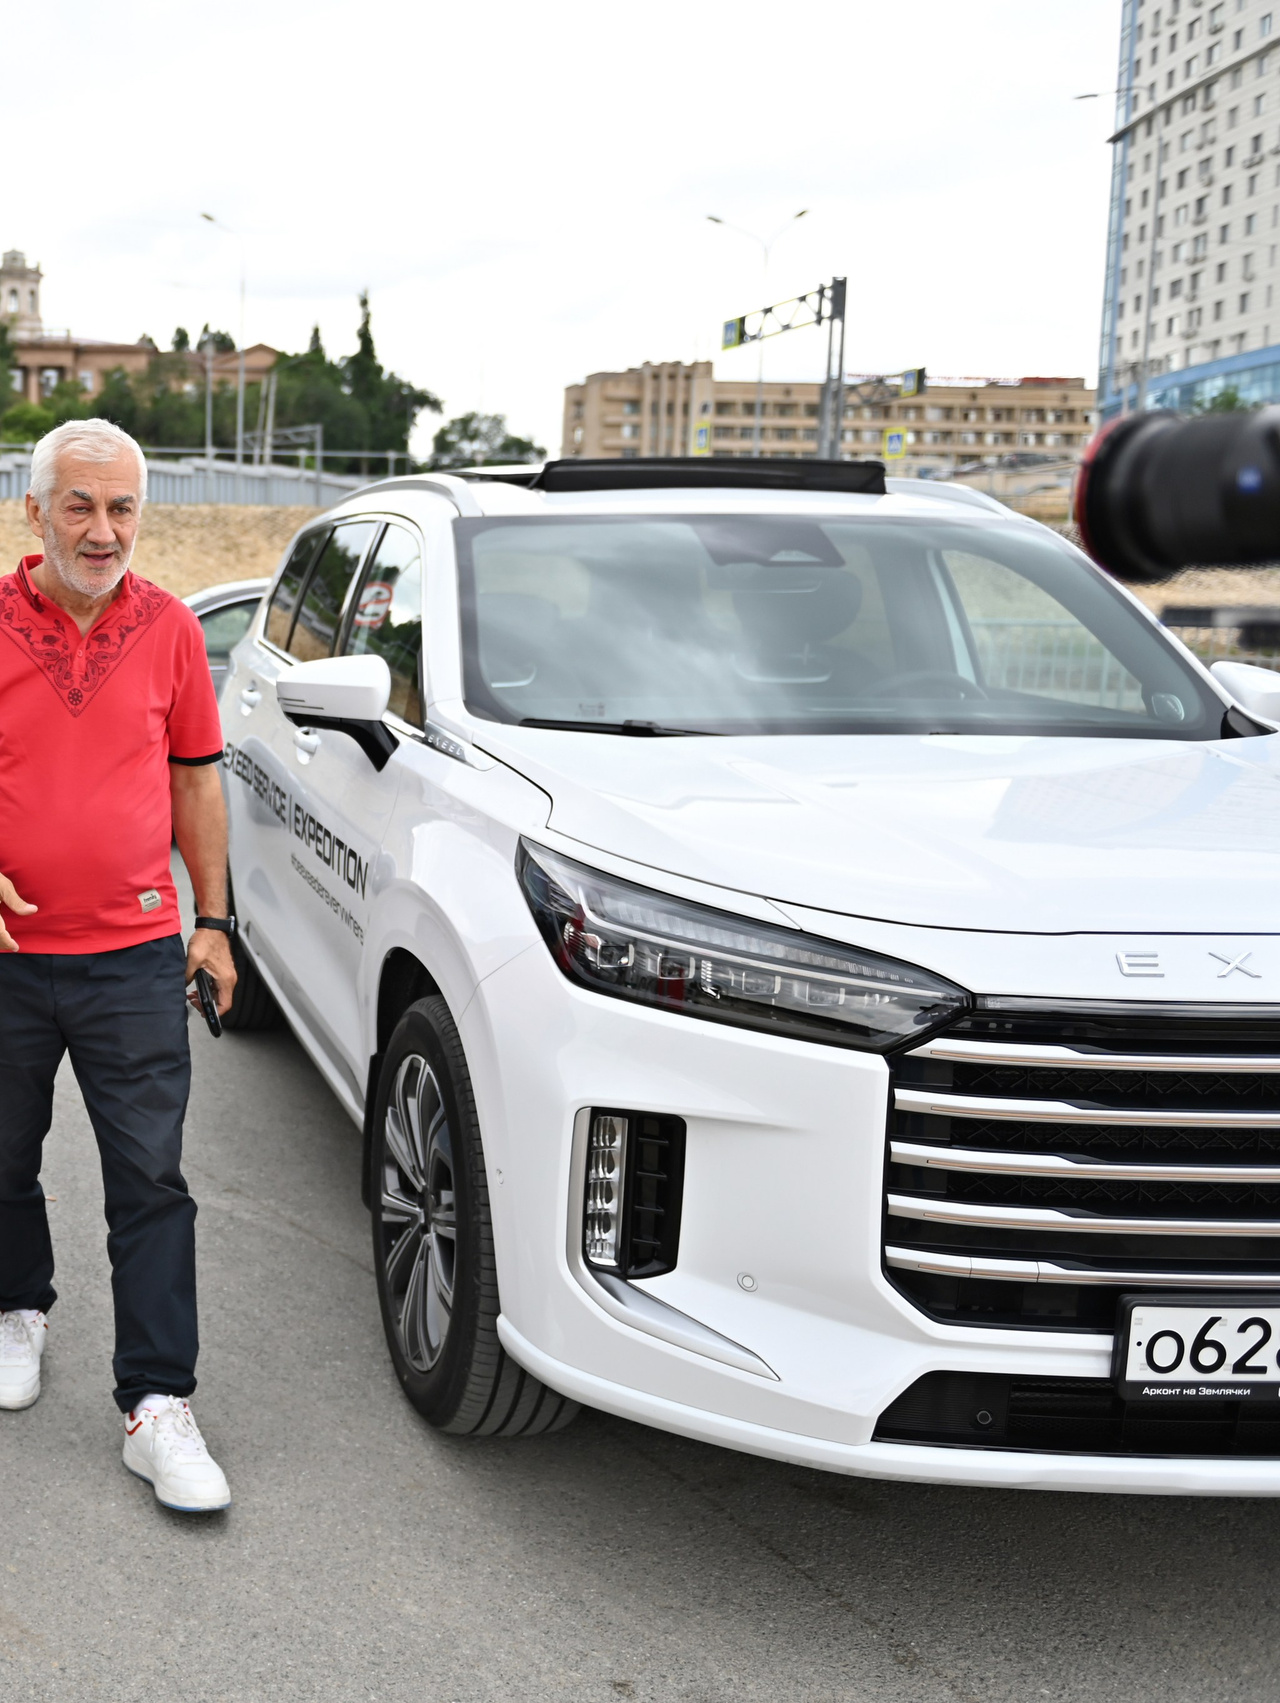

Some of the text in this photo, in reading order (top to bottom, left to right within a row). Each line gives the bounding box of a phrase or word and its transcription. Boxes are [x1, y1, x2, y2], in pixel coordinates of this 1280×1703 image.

[223, 742, 369, 901] EXEED SERVICE EXPEDITION
[1115, 951, 1263, 979] EX
[1145, 1316, 1280, 1375] О62
[1142, 1386, 1251, 1397] Арконт на Землячки
